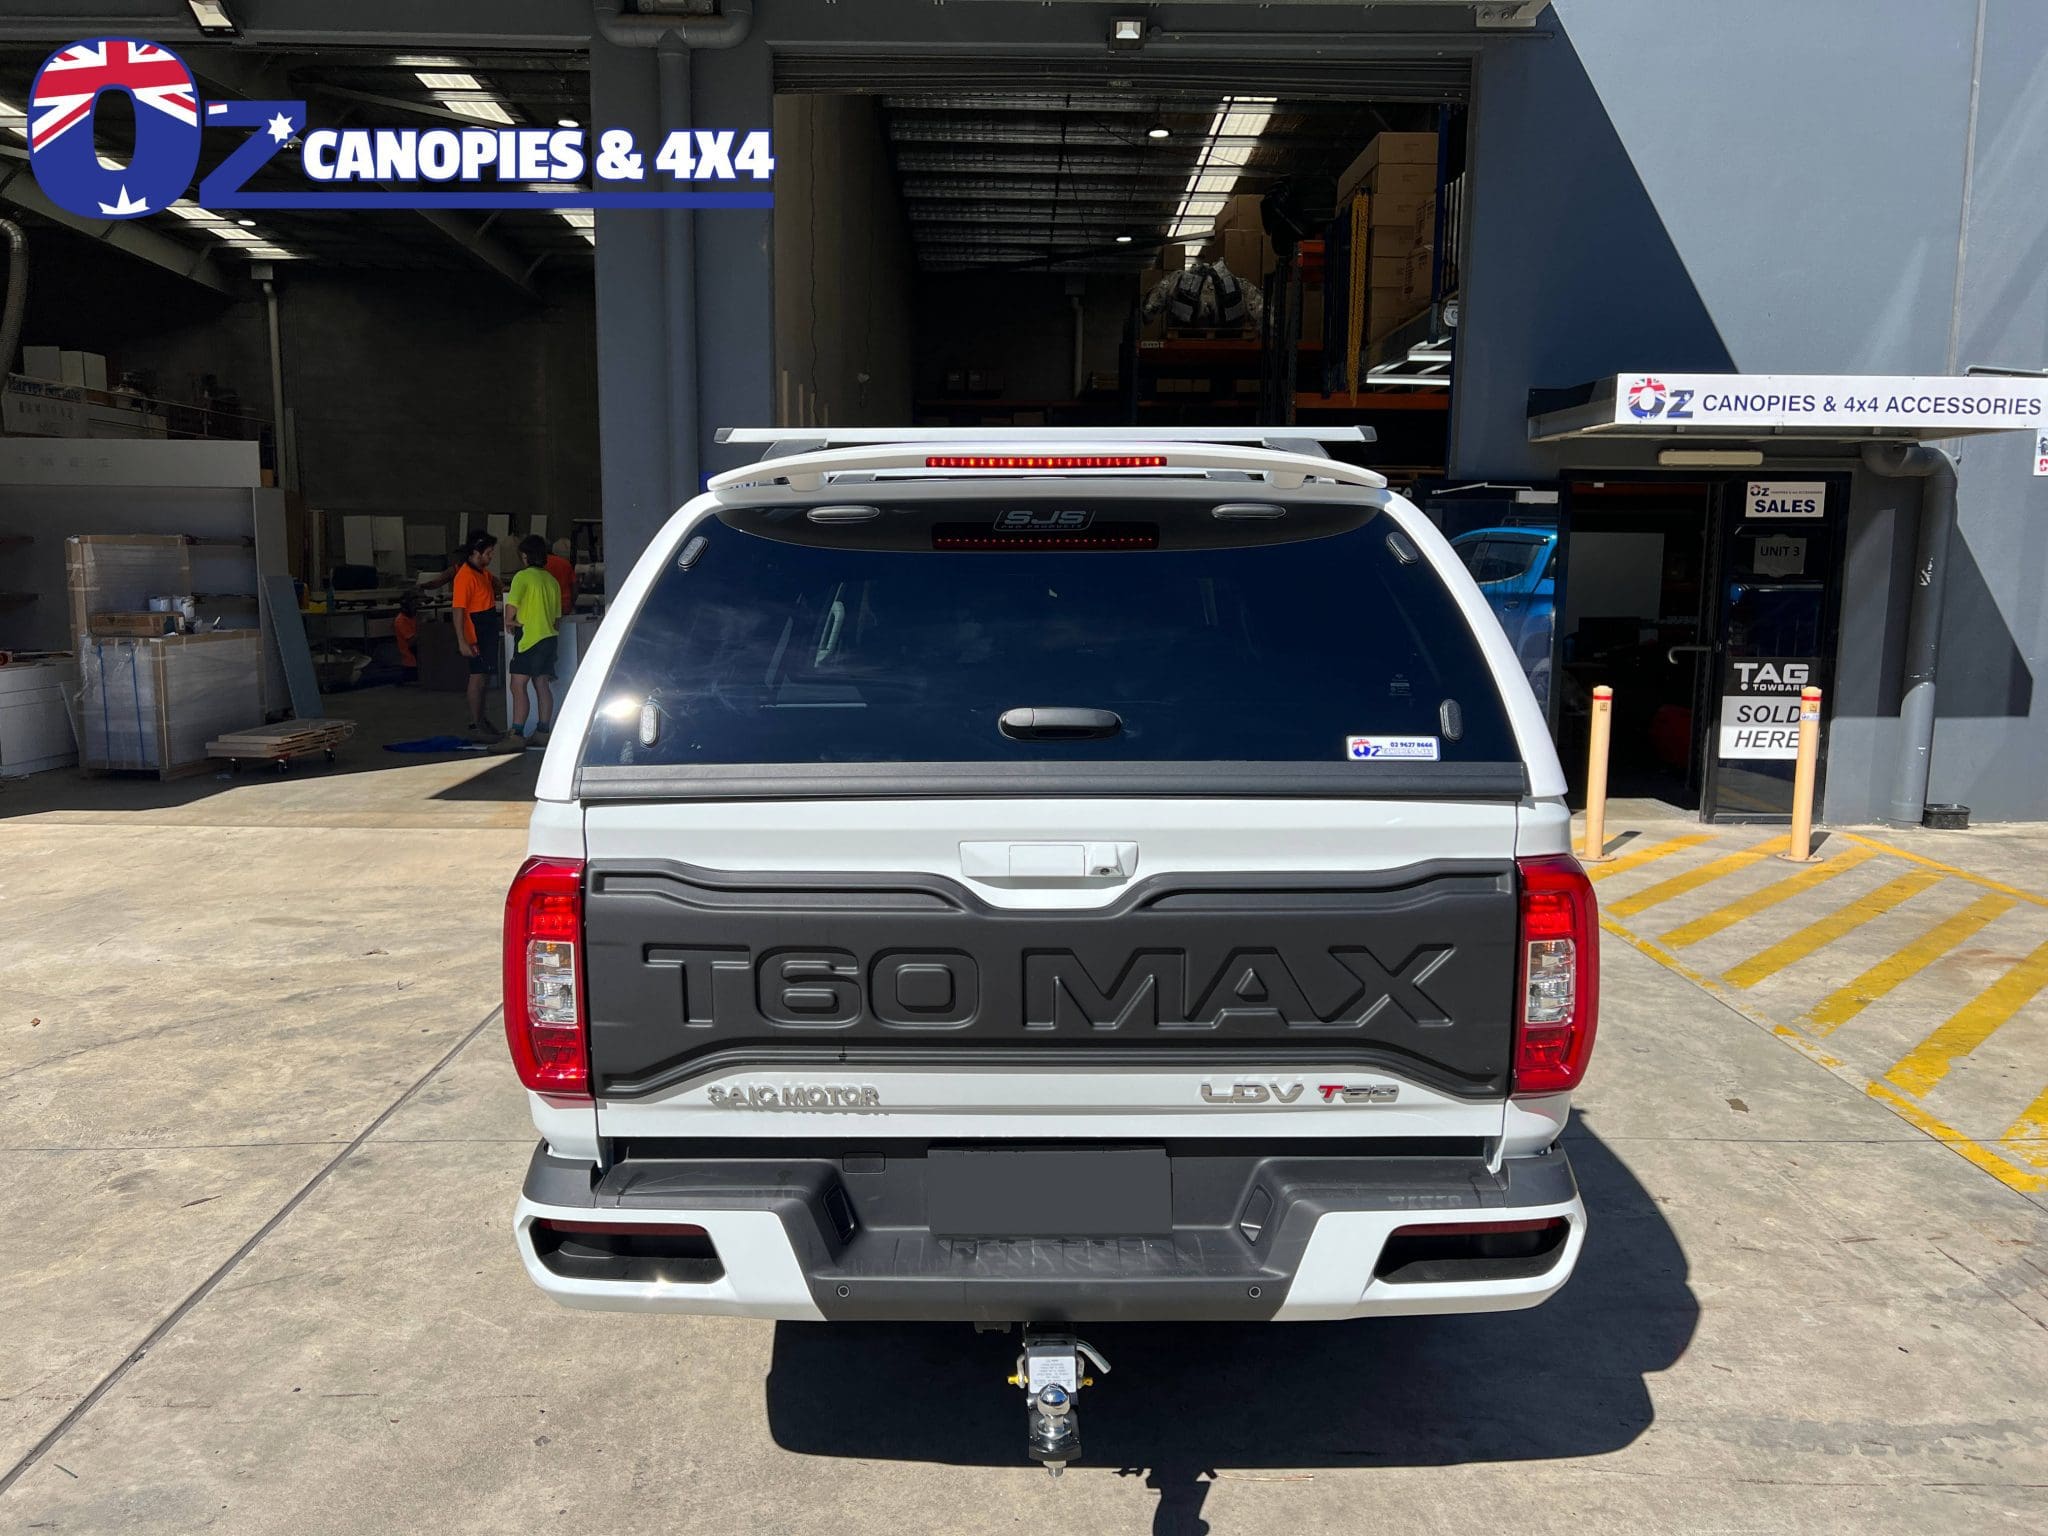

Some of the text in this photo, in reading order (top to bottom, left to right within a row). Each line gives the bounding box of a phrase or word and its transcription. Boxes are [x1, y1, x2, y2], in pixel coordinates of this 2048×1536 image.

[1703, 394, 1816, 412] CANOPIES
[1823, 395, 1837, 412] &
[1844, 396, 1879, 412] 4x4
[1885, 396, 2042, 415] ACCESSORIES
[1754, 499, 1816, 513] SALES
[1004, 510, 1087, 525] SJS
[1760, 546, 1800, 557] UNIT 3
[1733, 662, 1809, 685] TAG
[1736, 705, 1802, 723] SOLD
[1734, 730, 1800, 748] HERE
[642, 942, 1456, 1031] T60 MAX
[781, 1083, 881, 1108] MOTOR
[1200, 1080, 1305, 1103] LDV
